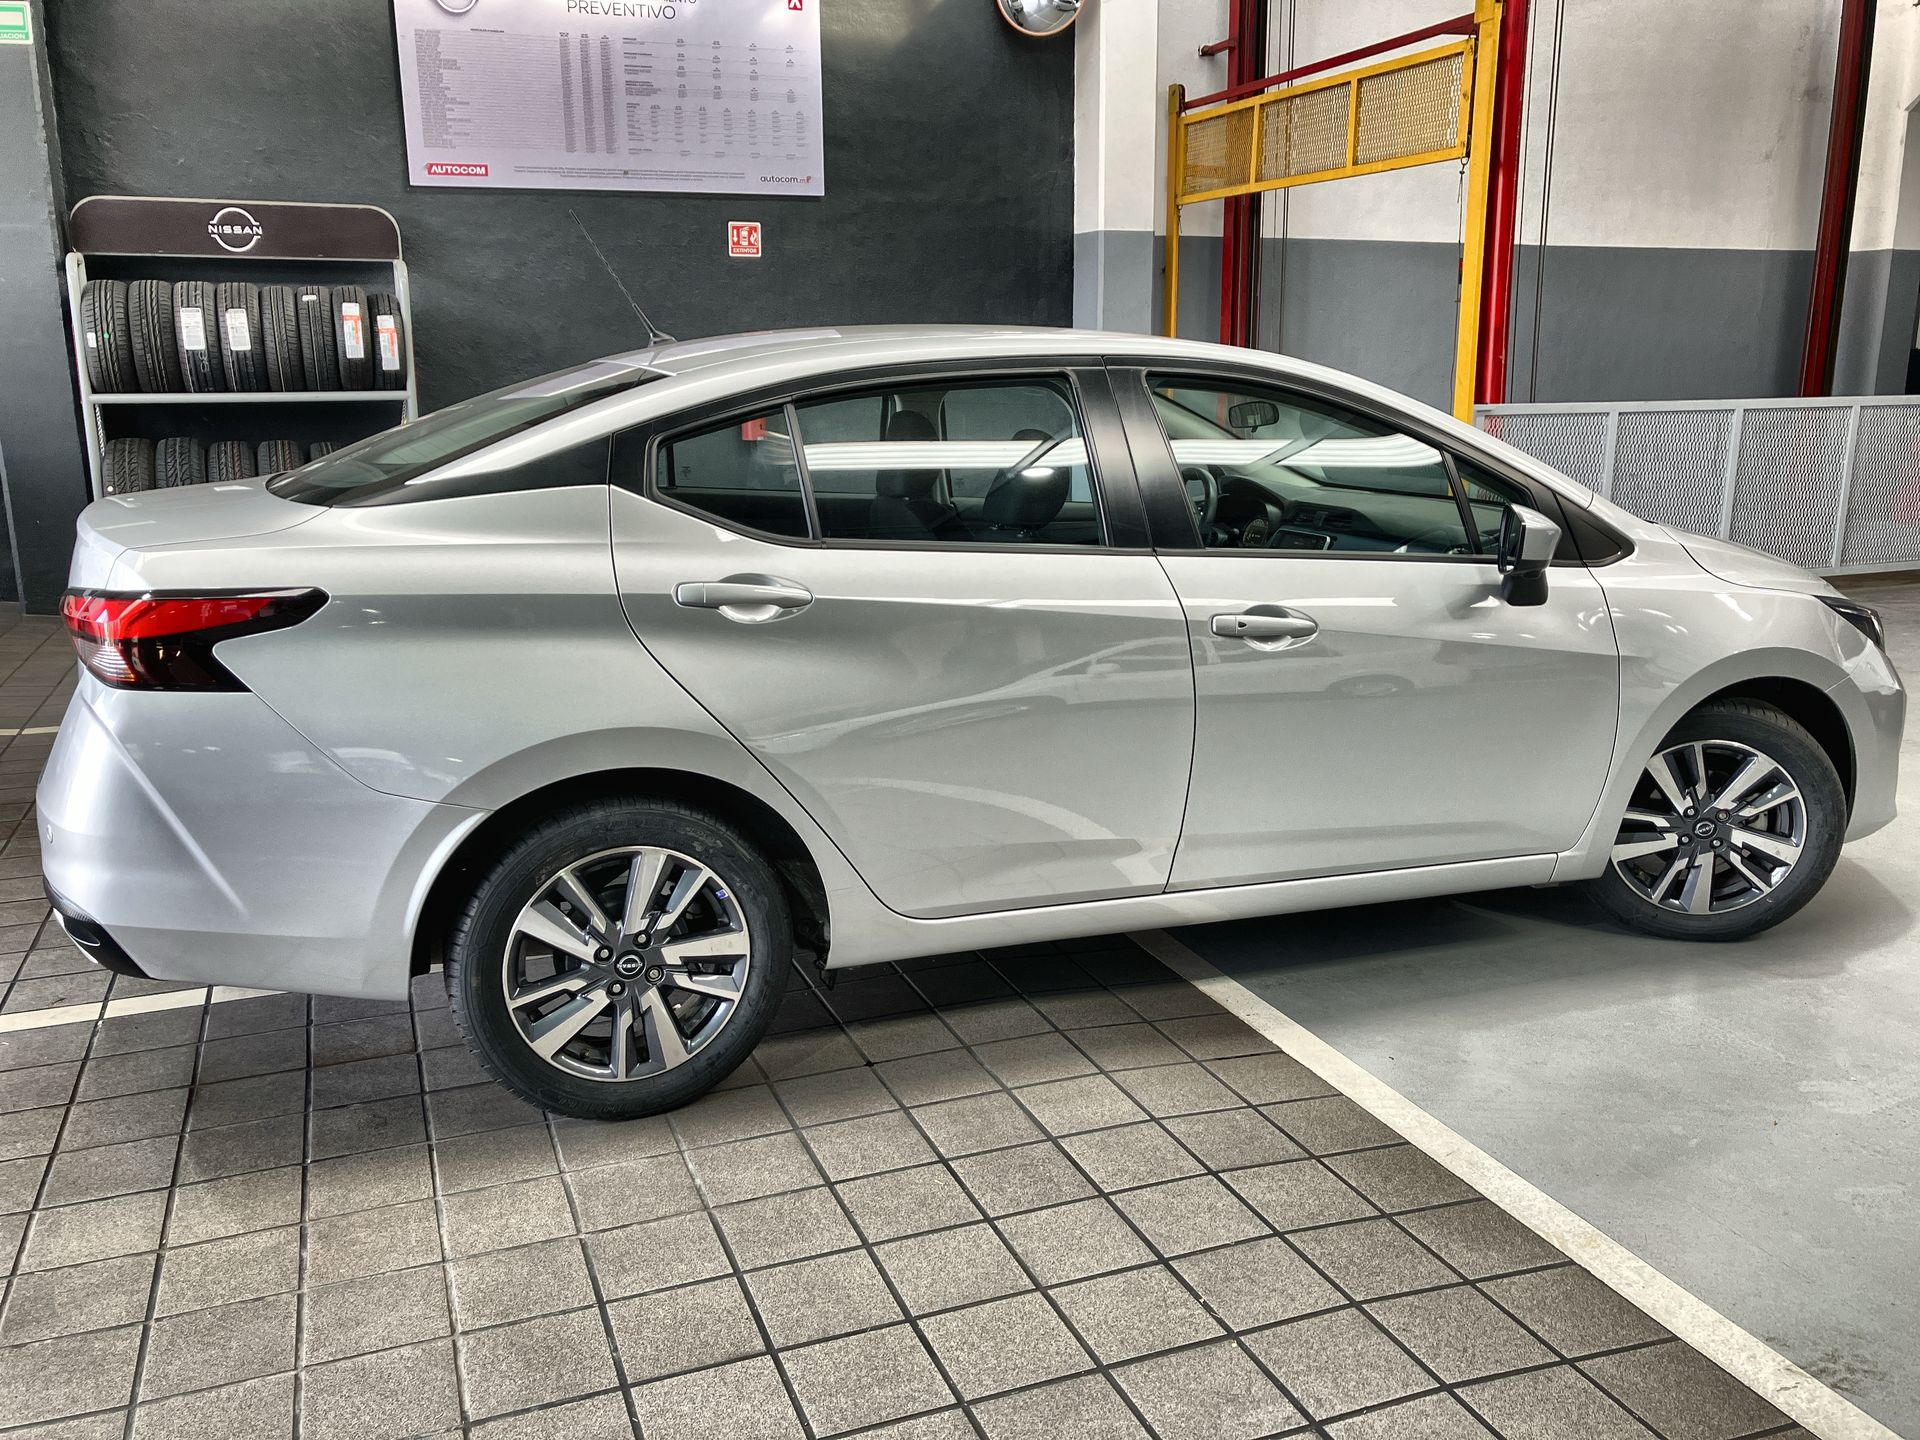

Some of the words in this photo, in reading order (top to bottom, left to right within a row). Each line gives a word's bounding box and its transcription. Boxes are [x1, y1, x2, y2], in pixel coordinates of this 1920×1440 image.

[567, 0, 676, 19] PREVENTIVO
[430, 165, 486, 175] AUTOCOM
[208, 224, 263, 235] NISSAN
